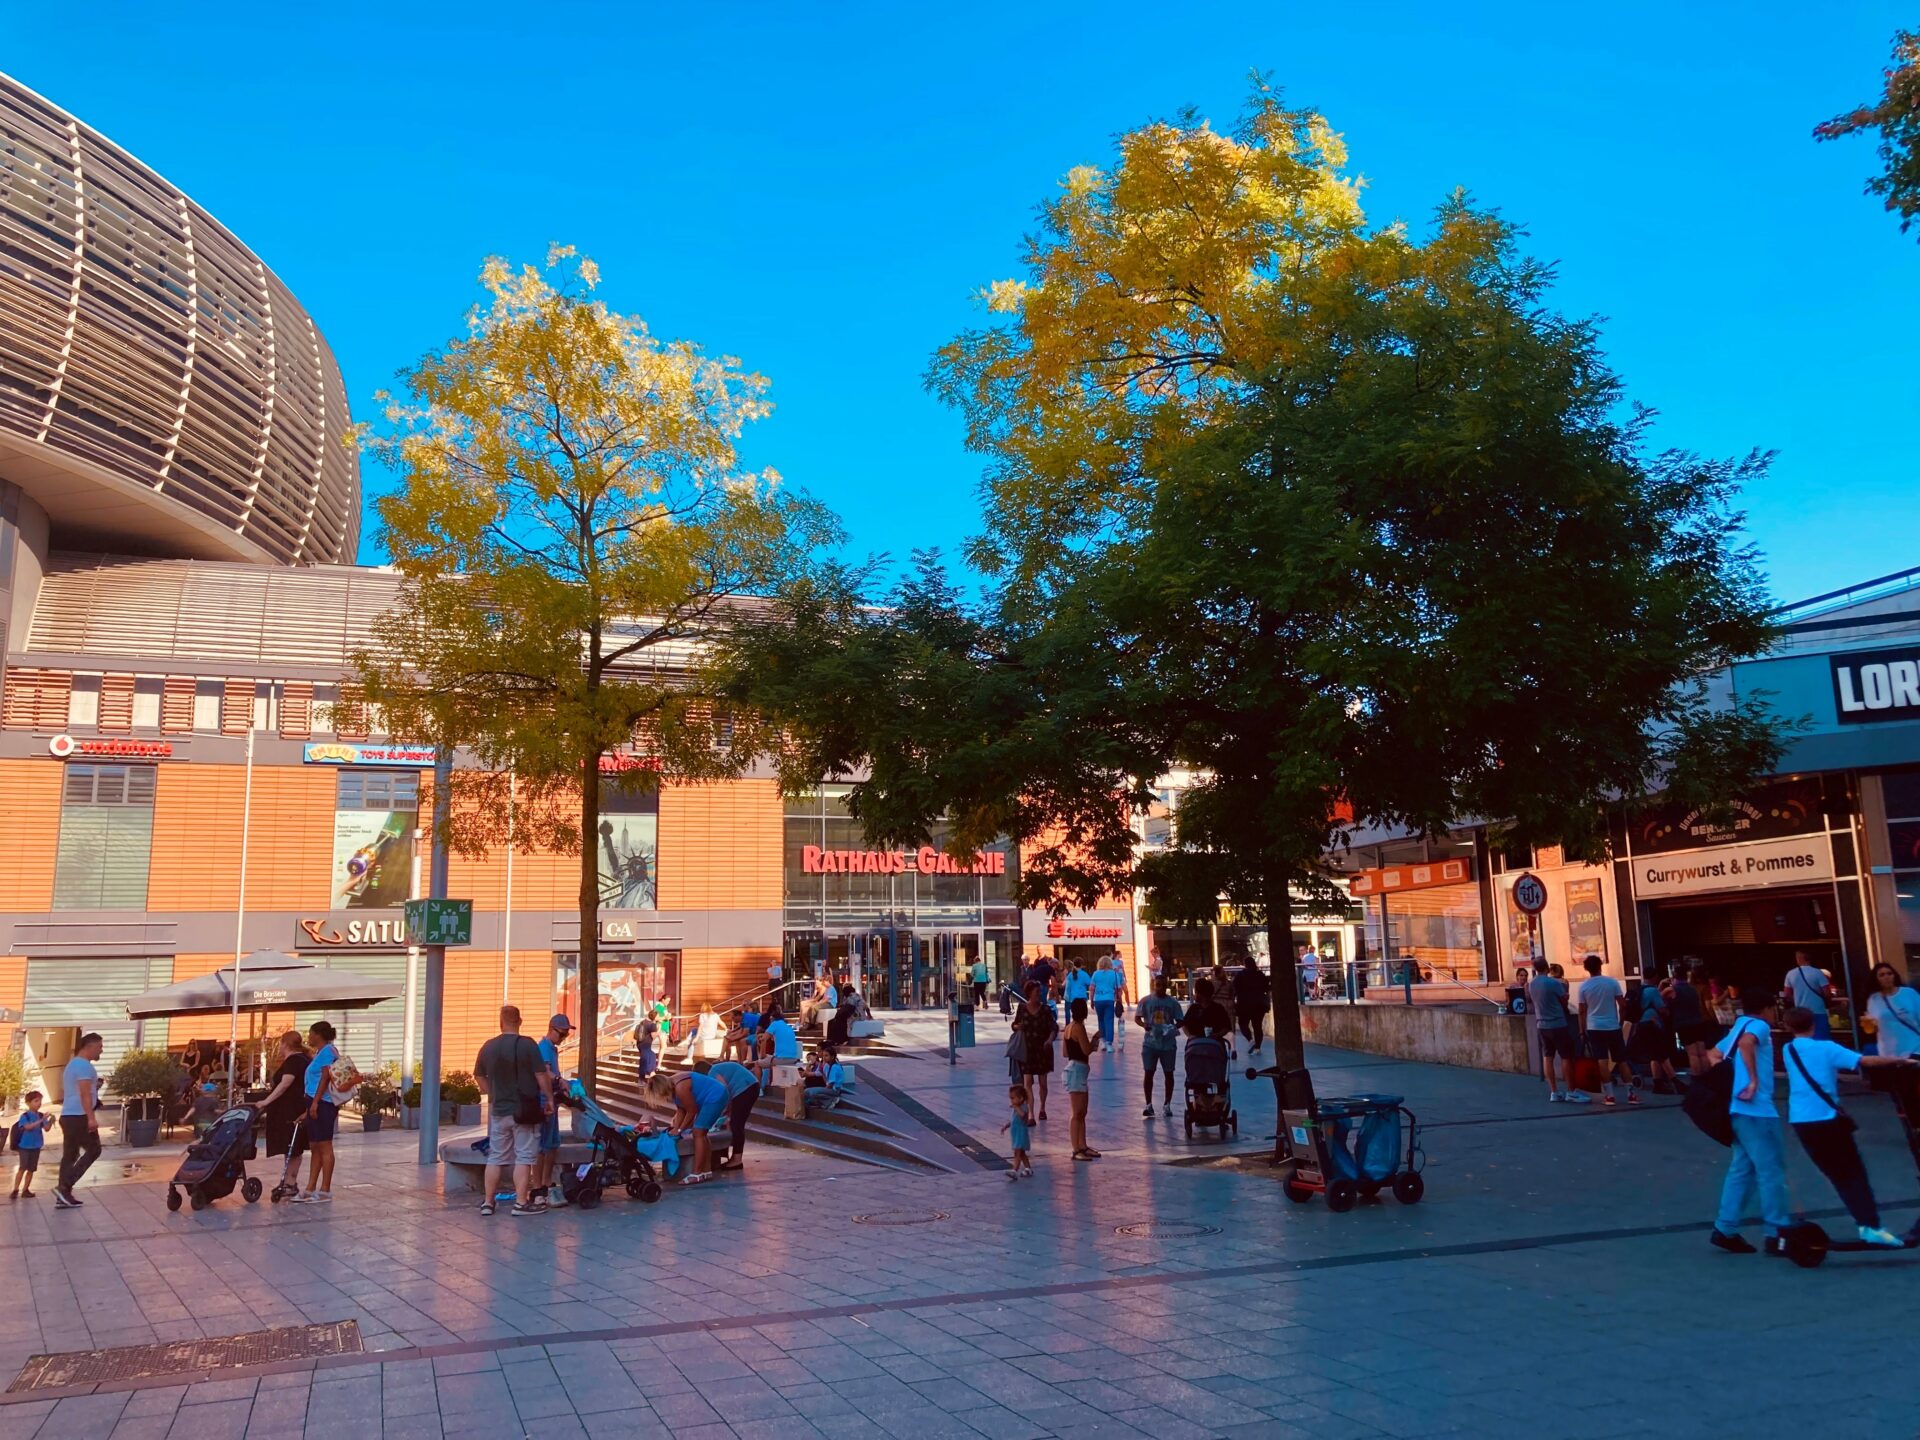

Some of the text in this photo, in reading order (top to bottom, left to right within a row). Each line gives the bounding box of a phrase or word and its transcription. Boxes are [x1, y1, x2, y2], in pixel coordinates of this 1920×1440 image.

[1837, 660, 1920, 712] LOR
[82, 738, 173, 755] vodafone
[311, 746, 356, 761] SMYTHS
[361, 750, 385, 760] TOYS
[803, 845, 1005, 874] RATHAUS-GALRIE
[1646, 854, 1815, 884] Currywurst & Pommes
[606, 922, 633, 937] C&A
[1070, 926, 1123, 938] Sparkasse
